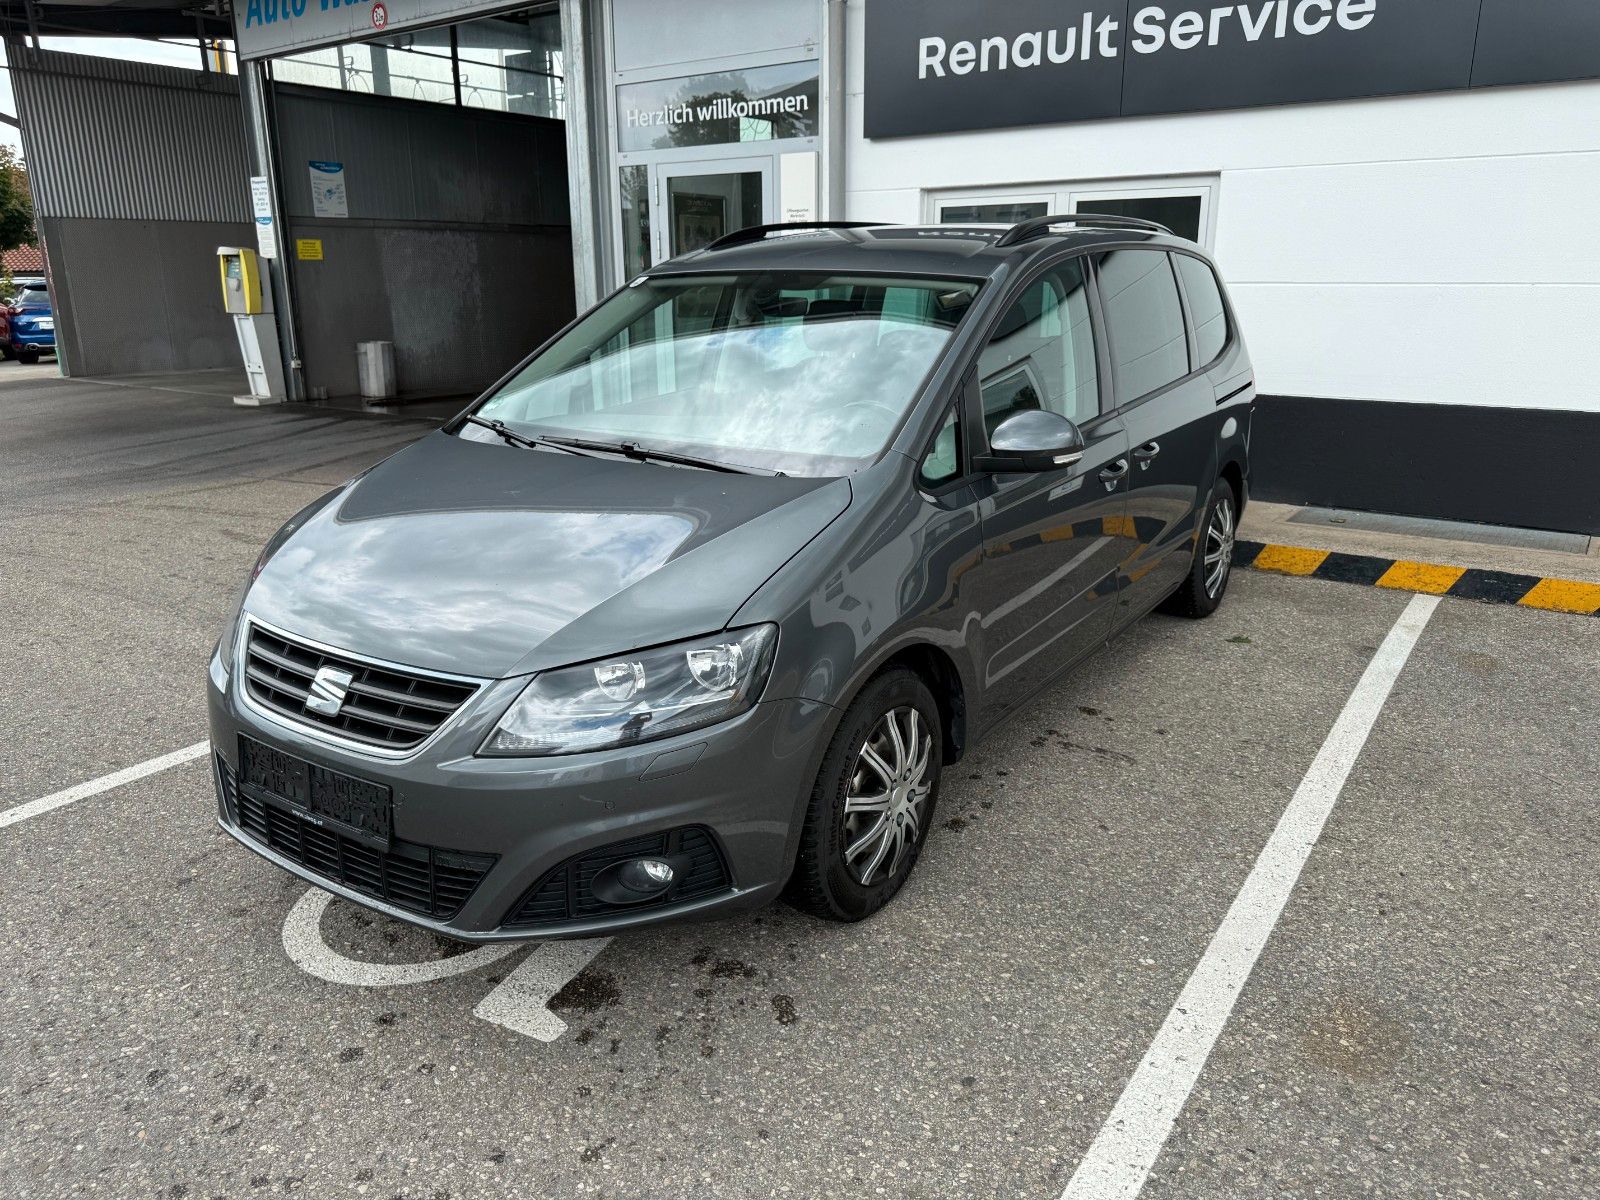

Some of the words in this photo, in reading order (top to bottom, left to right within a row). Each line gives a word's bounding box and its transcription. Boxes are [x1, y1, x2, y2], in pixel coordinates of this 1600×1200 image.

[918, 12, 1119, 79] Renault
[1131, 0, 1377, 54] Service
[627, 104, 693, 128] Herzlich
[697, 95, 808, 122] willkommen
